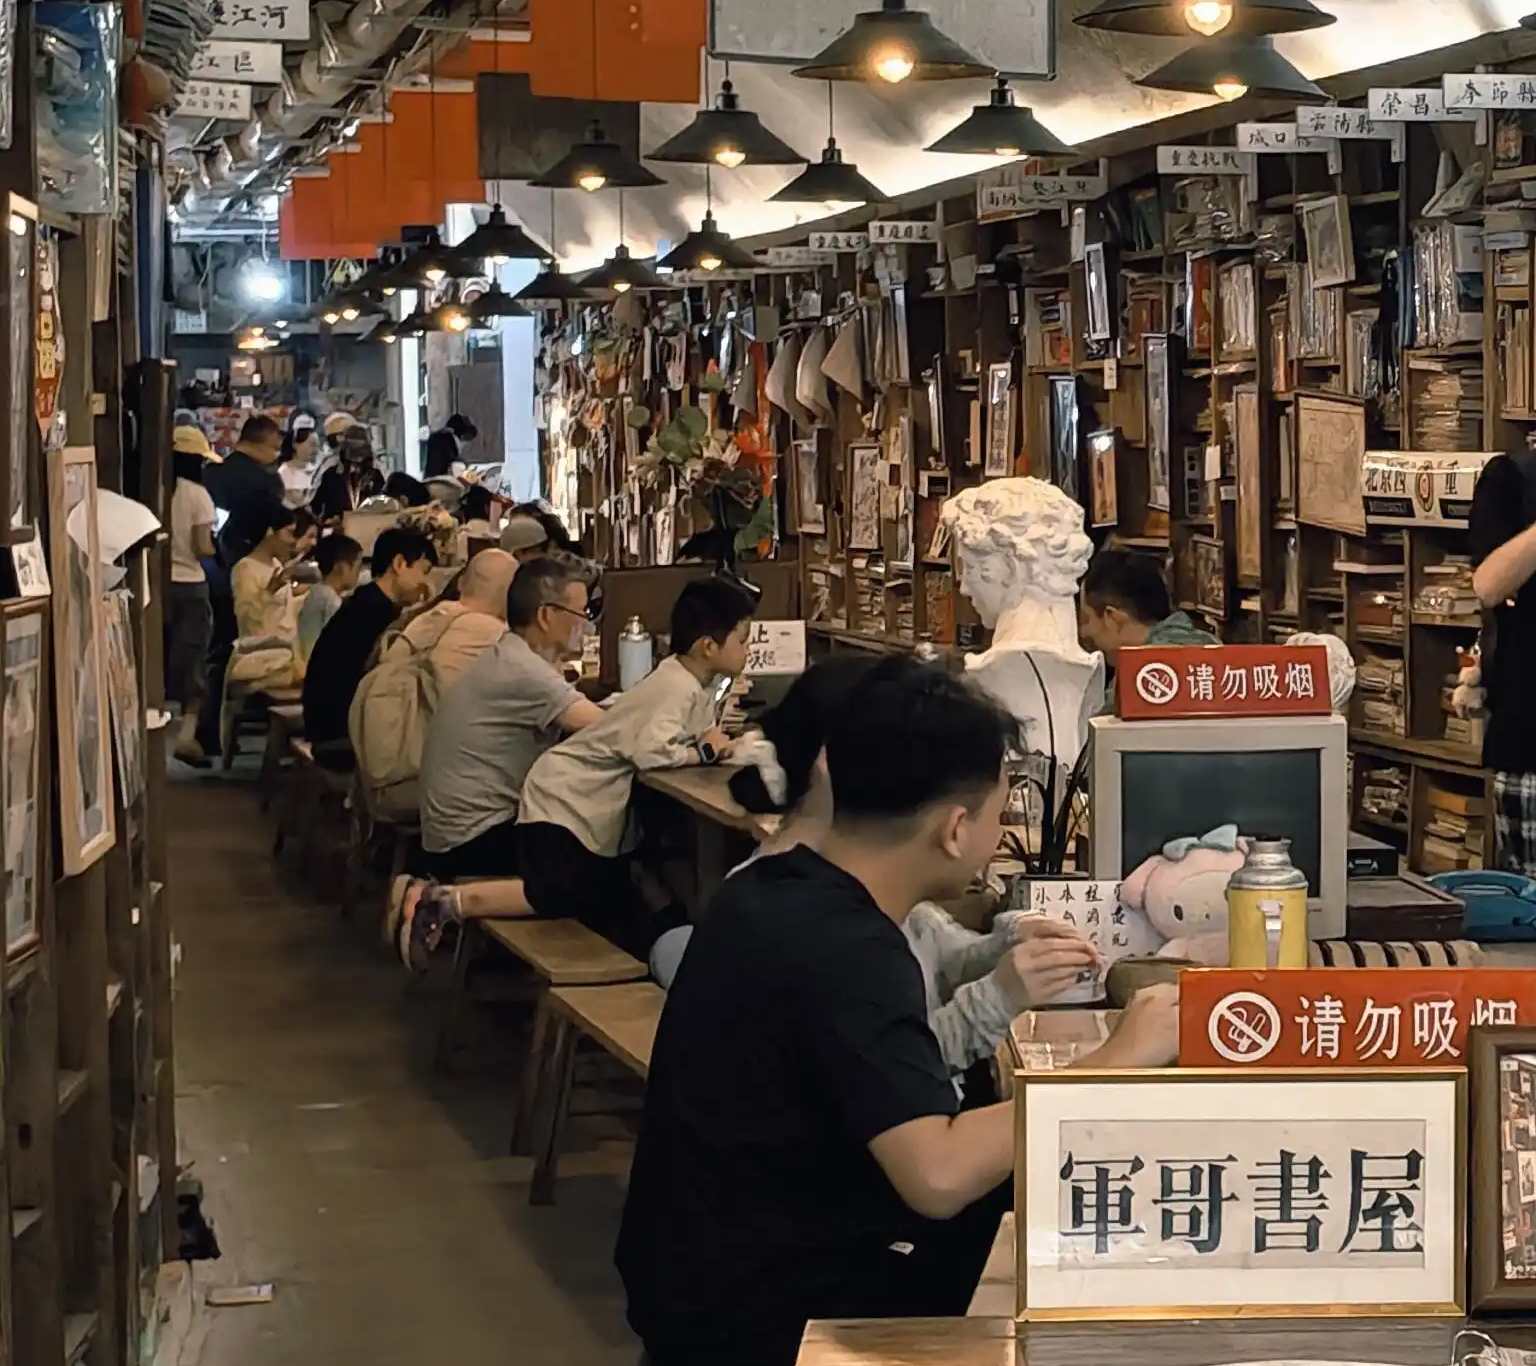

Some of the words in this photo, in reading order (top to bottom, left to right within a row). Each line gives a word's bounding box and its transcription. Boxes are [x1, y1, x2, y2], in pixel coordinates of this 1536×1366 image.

[1186, 661, 1315, 701] 请勿吸烟
[1058, 1148, 1425, 1255] 軍哥書屋
